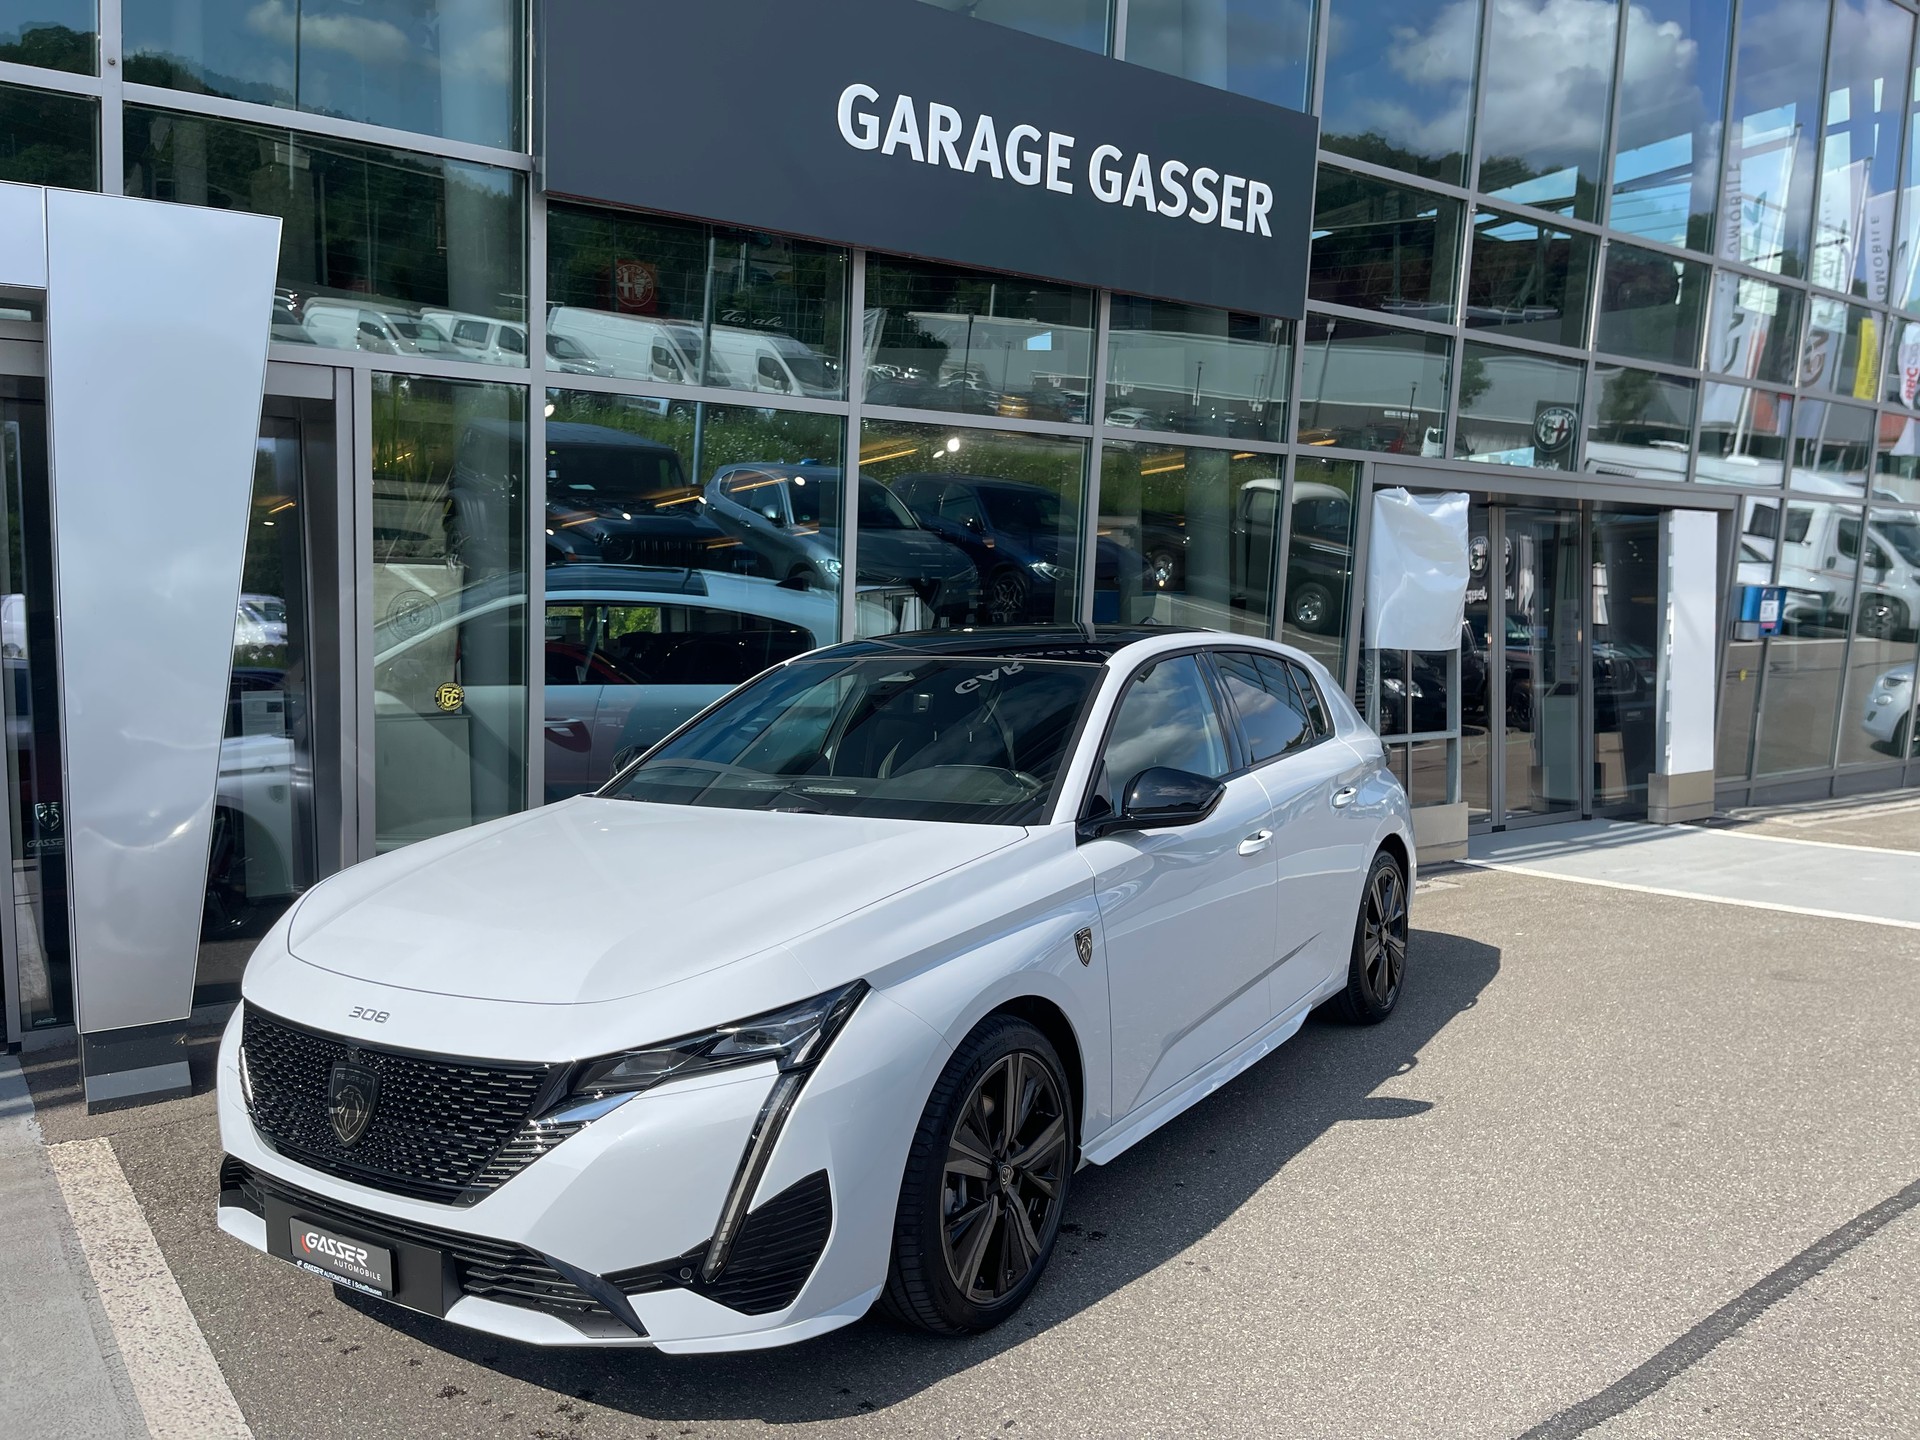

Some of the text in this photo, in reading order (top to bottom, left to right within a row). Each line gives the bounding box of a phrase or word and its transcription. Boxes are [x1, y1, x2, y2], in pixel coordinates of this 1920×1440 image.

[837, 83, 1273, 237] GARAGE GASSER
[27, 838, 65, 848] GASSE
[348, 1006, 390, 1023] 308
[336, 1073, 371, 1086] PEUGEOT
[305, 1232, 368, 1268] GASSER
[324, 1270, 351, 1286] AUTOMOBILE
[333, 1259, 382, 1281] AUTOMOBILE
